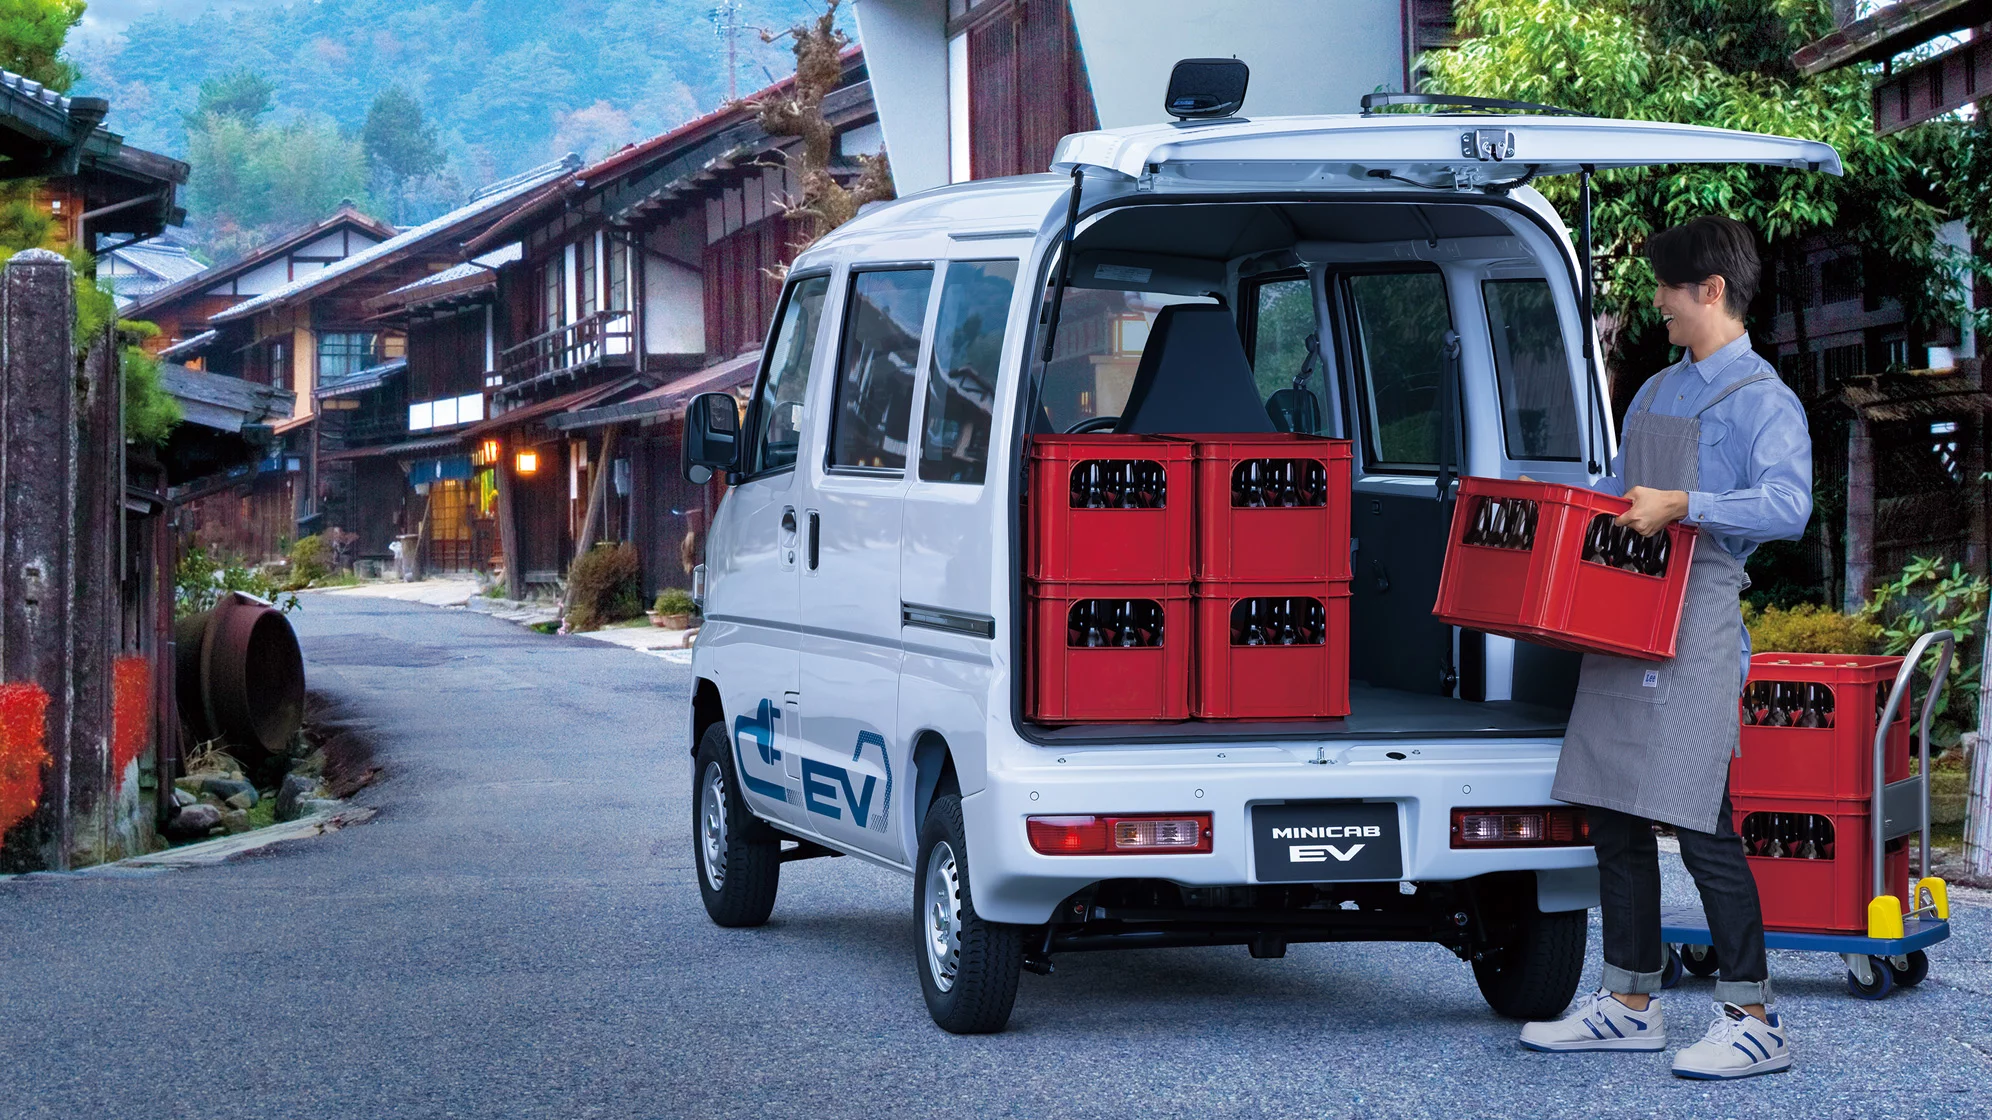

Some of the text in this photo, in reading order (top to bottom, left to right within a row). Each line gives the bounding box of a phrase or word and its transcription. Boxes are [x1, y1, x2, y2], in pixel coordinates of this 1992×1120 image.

[1645, 674, 1656, 683] Lee
[801, 757, 877, 828] EV
[1272, 826, 1381, 839] MINICAB
[1289, 844, 1366, 862] EV
